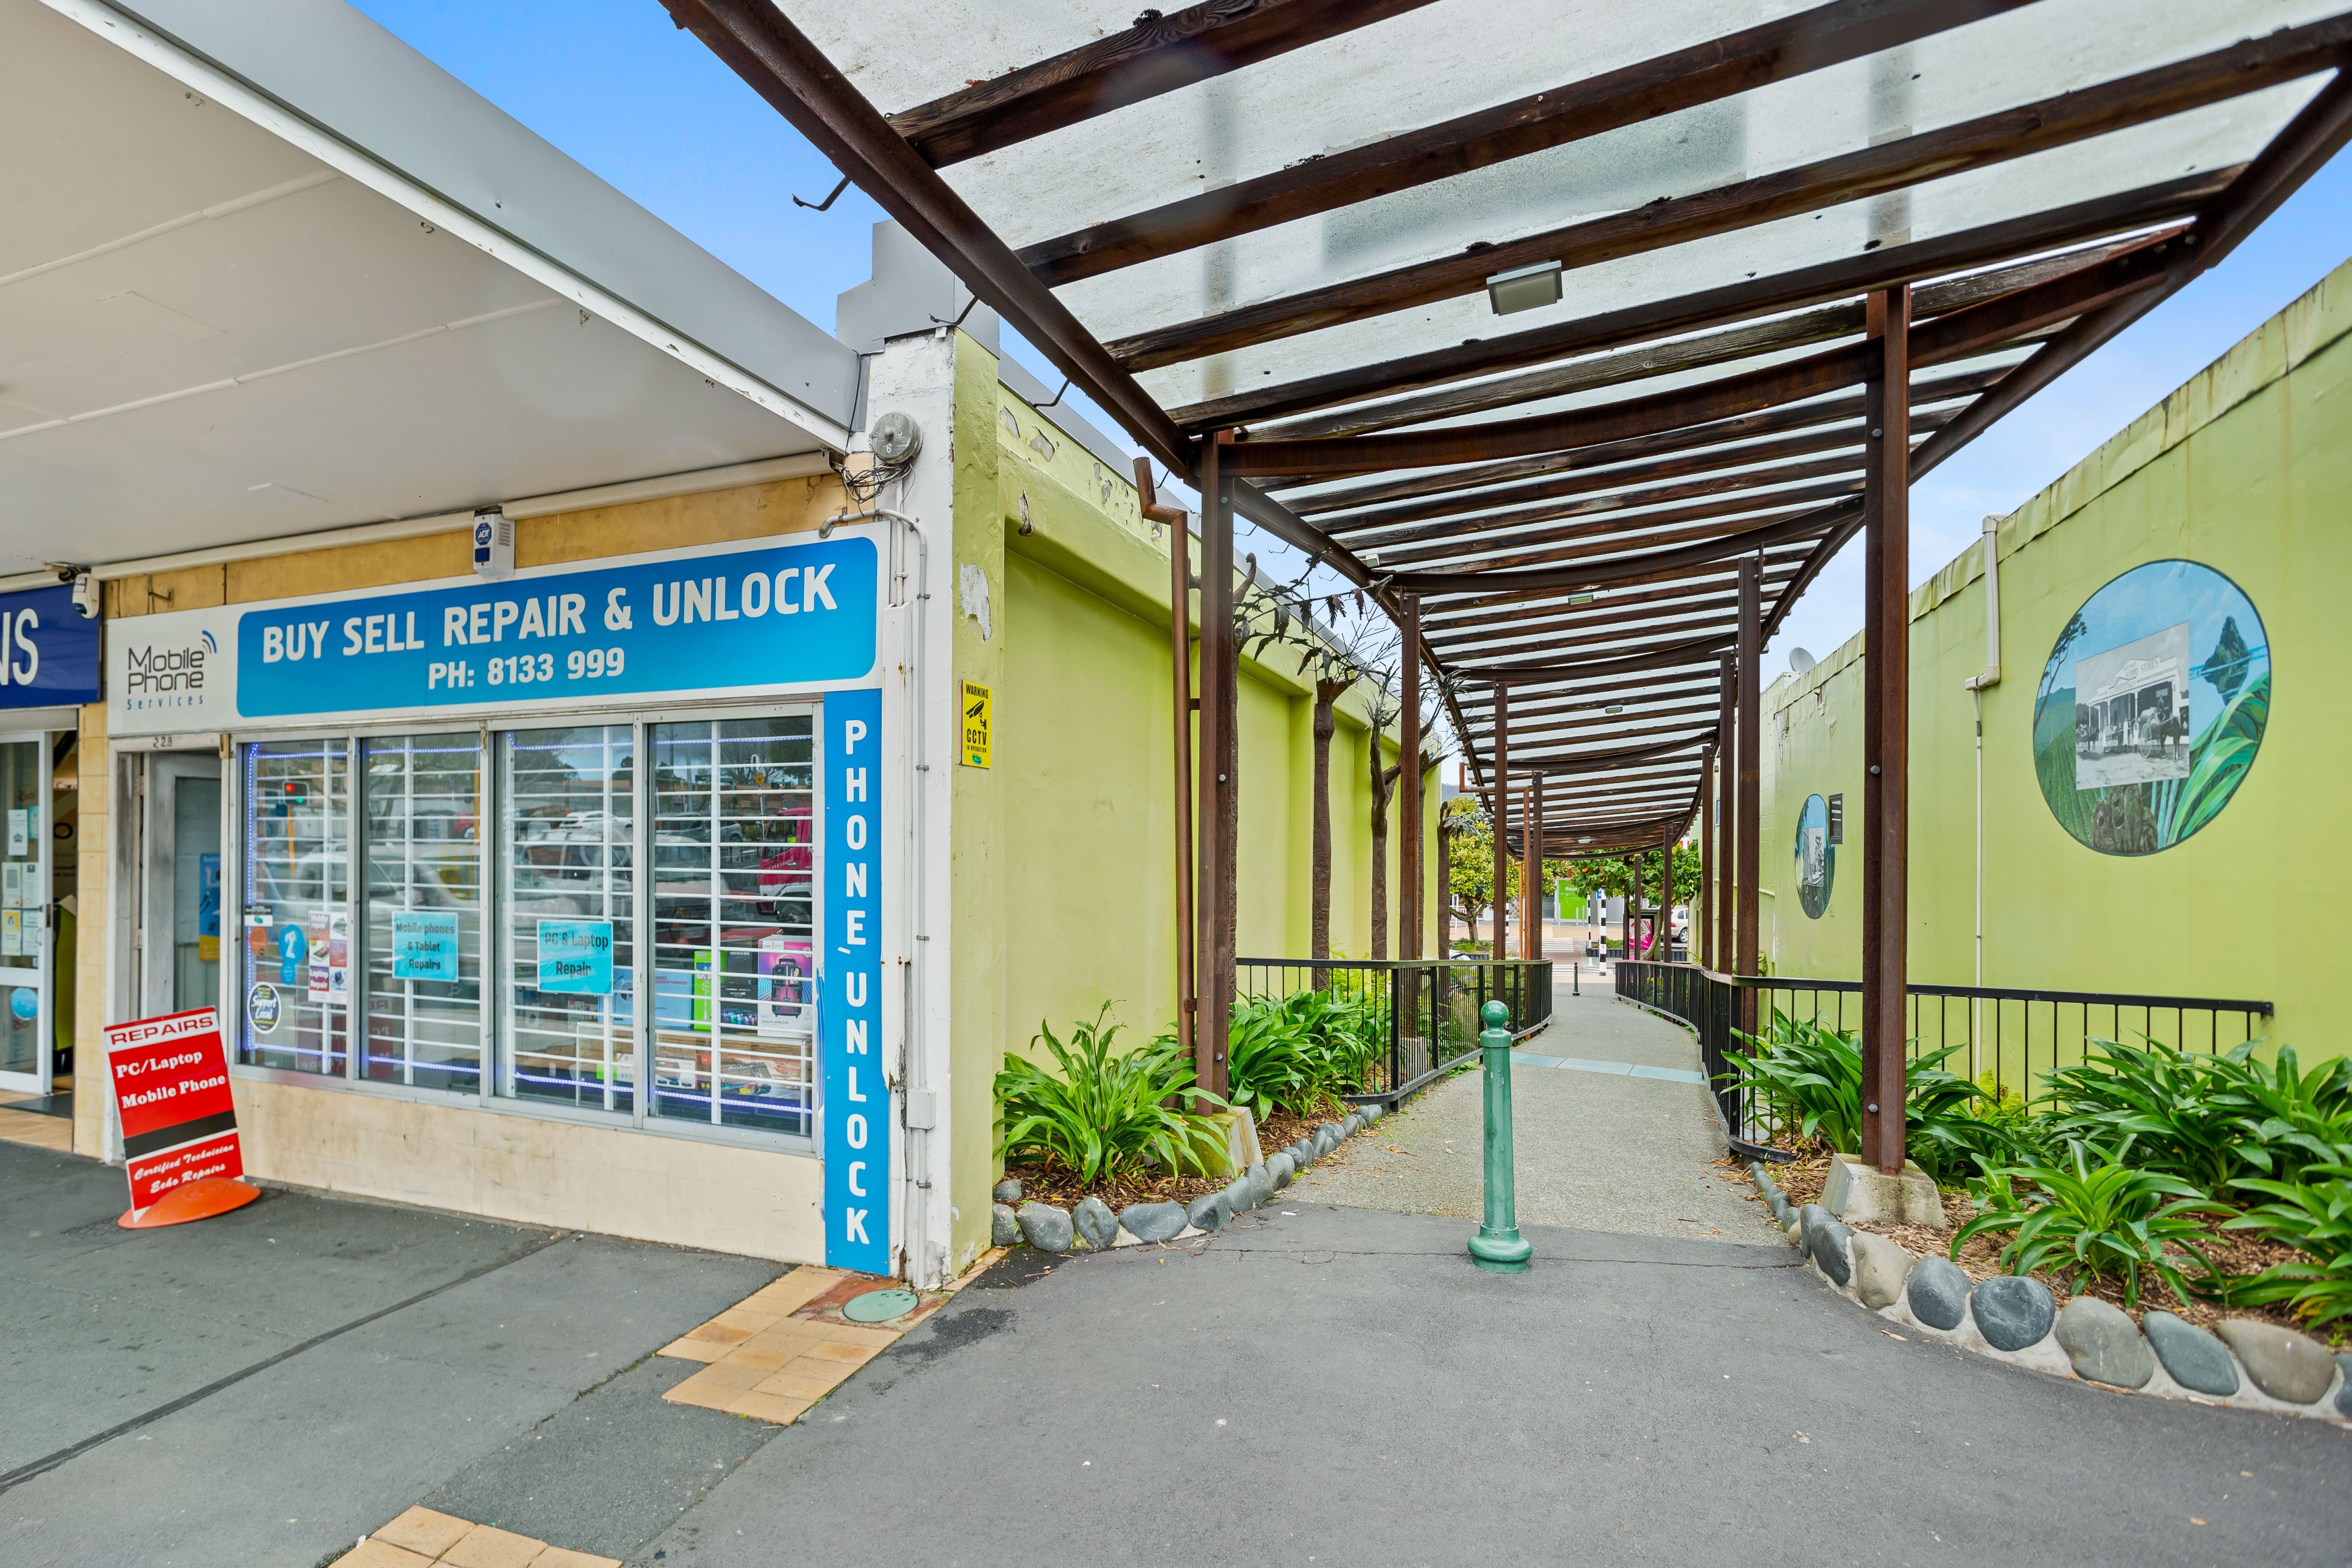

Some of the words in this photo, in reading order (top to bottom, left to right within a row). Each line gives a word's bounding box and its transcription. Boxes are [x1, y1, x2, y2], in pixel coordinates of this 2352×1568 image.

[478, 529, 490, 538] ADT
[263, 621, 330, 663] BUY
[343, 611, 425, 656] SELL
[444, 593, 586, 647] REPAIR
[603, 587, 633, 631] &
[652, 563, 838, 627] UNLOCK
[129, 645, 204, 674] Mobile
[429, 660, 475, 690] PH:
[487, 653, 554, 685] 8133
[567, 647, 625, 680] 999
[966, 683, 989, 699] WARNING
[127, 694, 203, 710] Services
[967, 728, 987, 746] CCTV
[971, 745, 987, 753] OPERATION
[845, 720, 867, 946] PHONE
[396, 922, 422, 933] Mobile
[424, 923, 455, 935] phones
[407, 941, 413, 951] &
[415, 940, 441, 952] Tablet
[545, 931, 558, 945] PC
[562, 932, 569, 946] &
[572, 932, 609, 951] Laptop
[309, 969, 329, 979] Laptop
[409, 959, 441, 971] Repairs
[555, 960, 591, 978] Repair
[110, 1016, 213, 1045] REPAIRS
[115, 1051, 203, 1079] PC/Laptop
[121, 1086, 176, 1109] Mobile
[178, 1075, 226, 1095] Phone
[846, 971, 870, 1245] UNLOCK
[134, 1159, 181, 1181] Certified
[182, 1143, 235, 1164] Technician
[181, 1163, 226, 1181] Repairs
